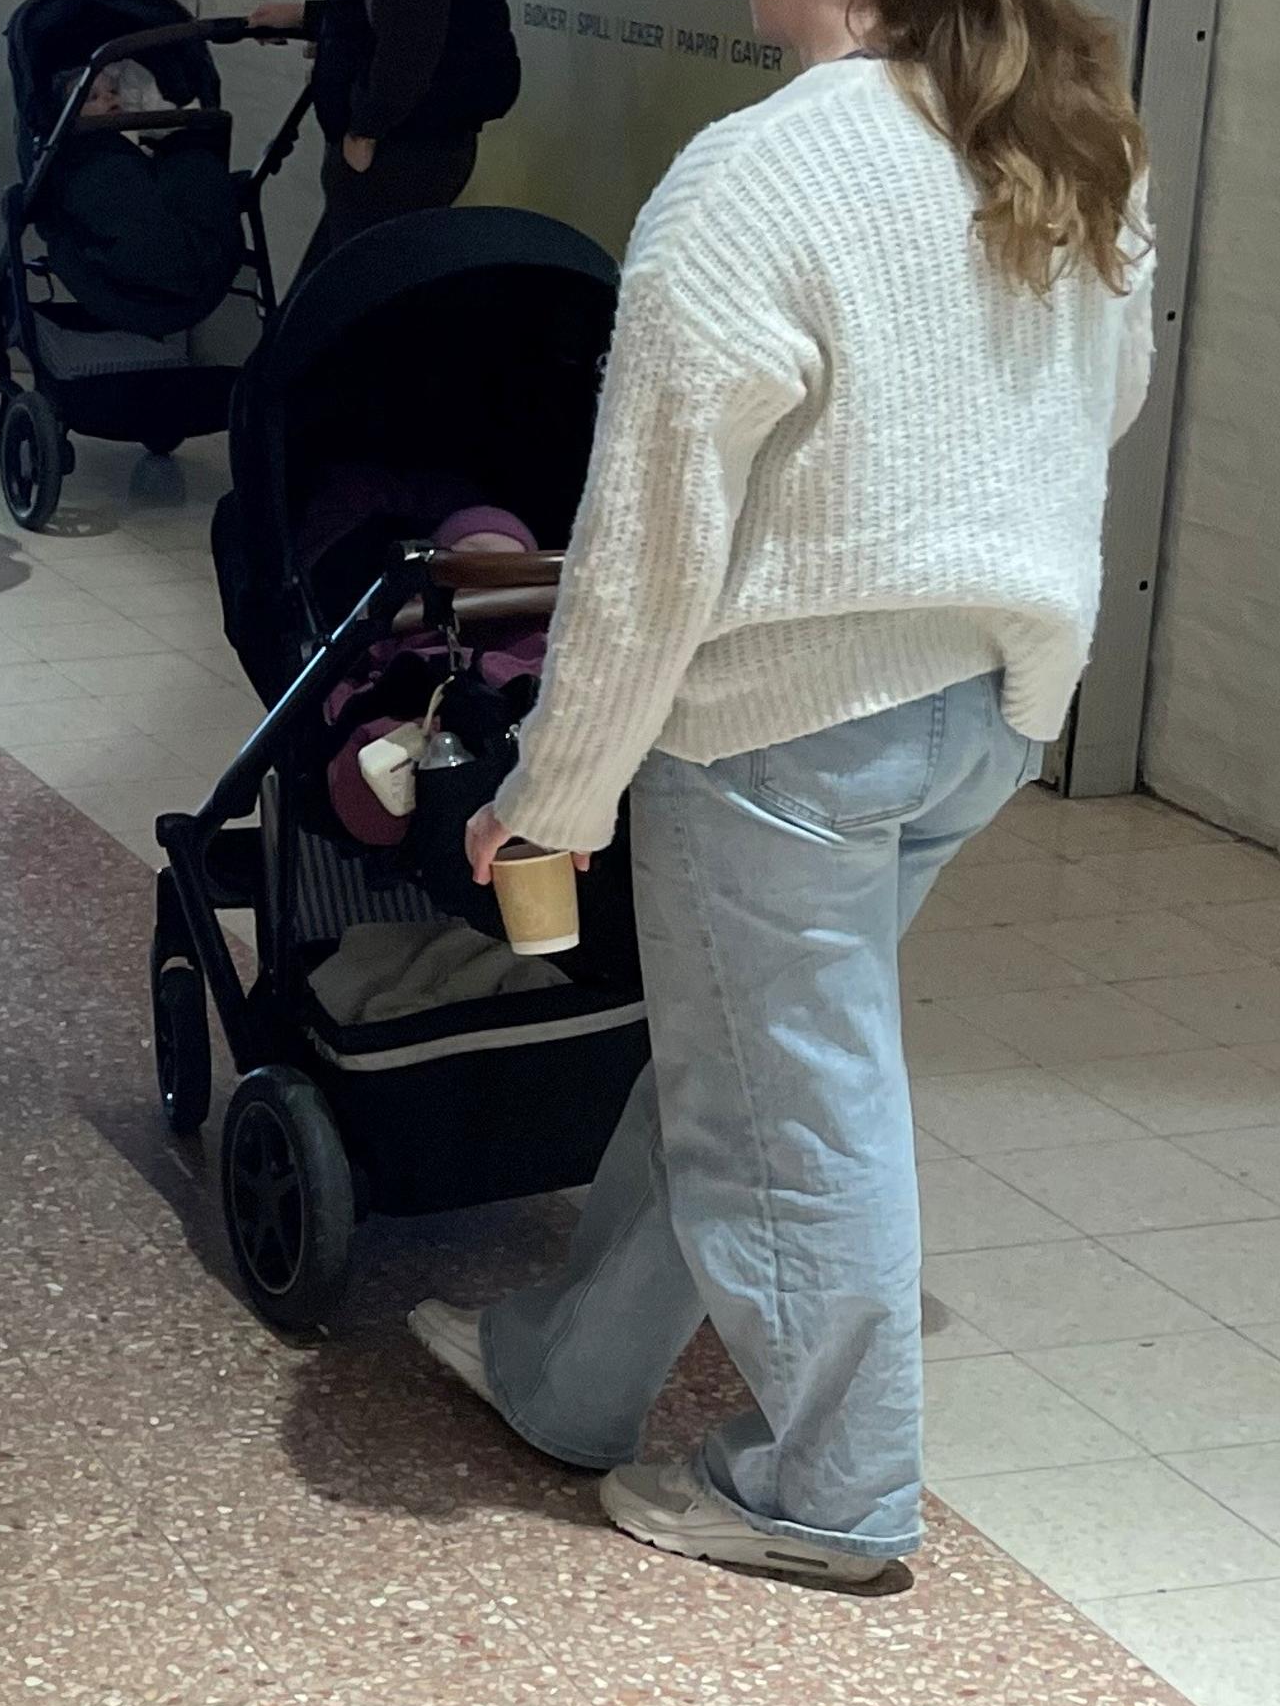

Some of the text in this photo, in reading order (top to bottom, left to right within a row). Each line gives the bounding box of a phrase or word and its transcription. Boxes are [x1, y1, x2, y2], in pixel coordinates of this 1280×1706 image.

[577, 12, 611, 39] SPILL
[621, 20, 664, 49] LEKER
[677, 29, 720, 59] PAPIR
[731, 39, 783, 71] GAVER
